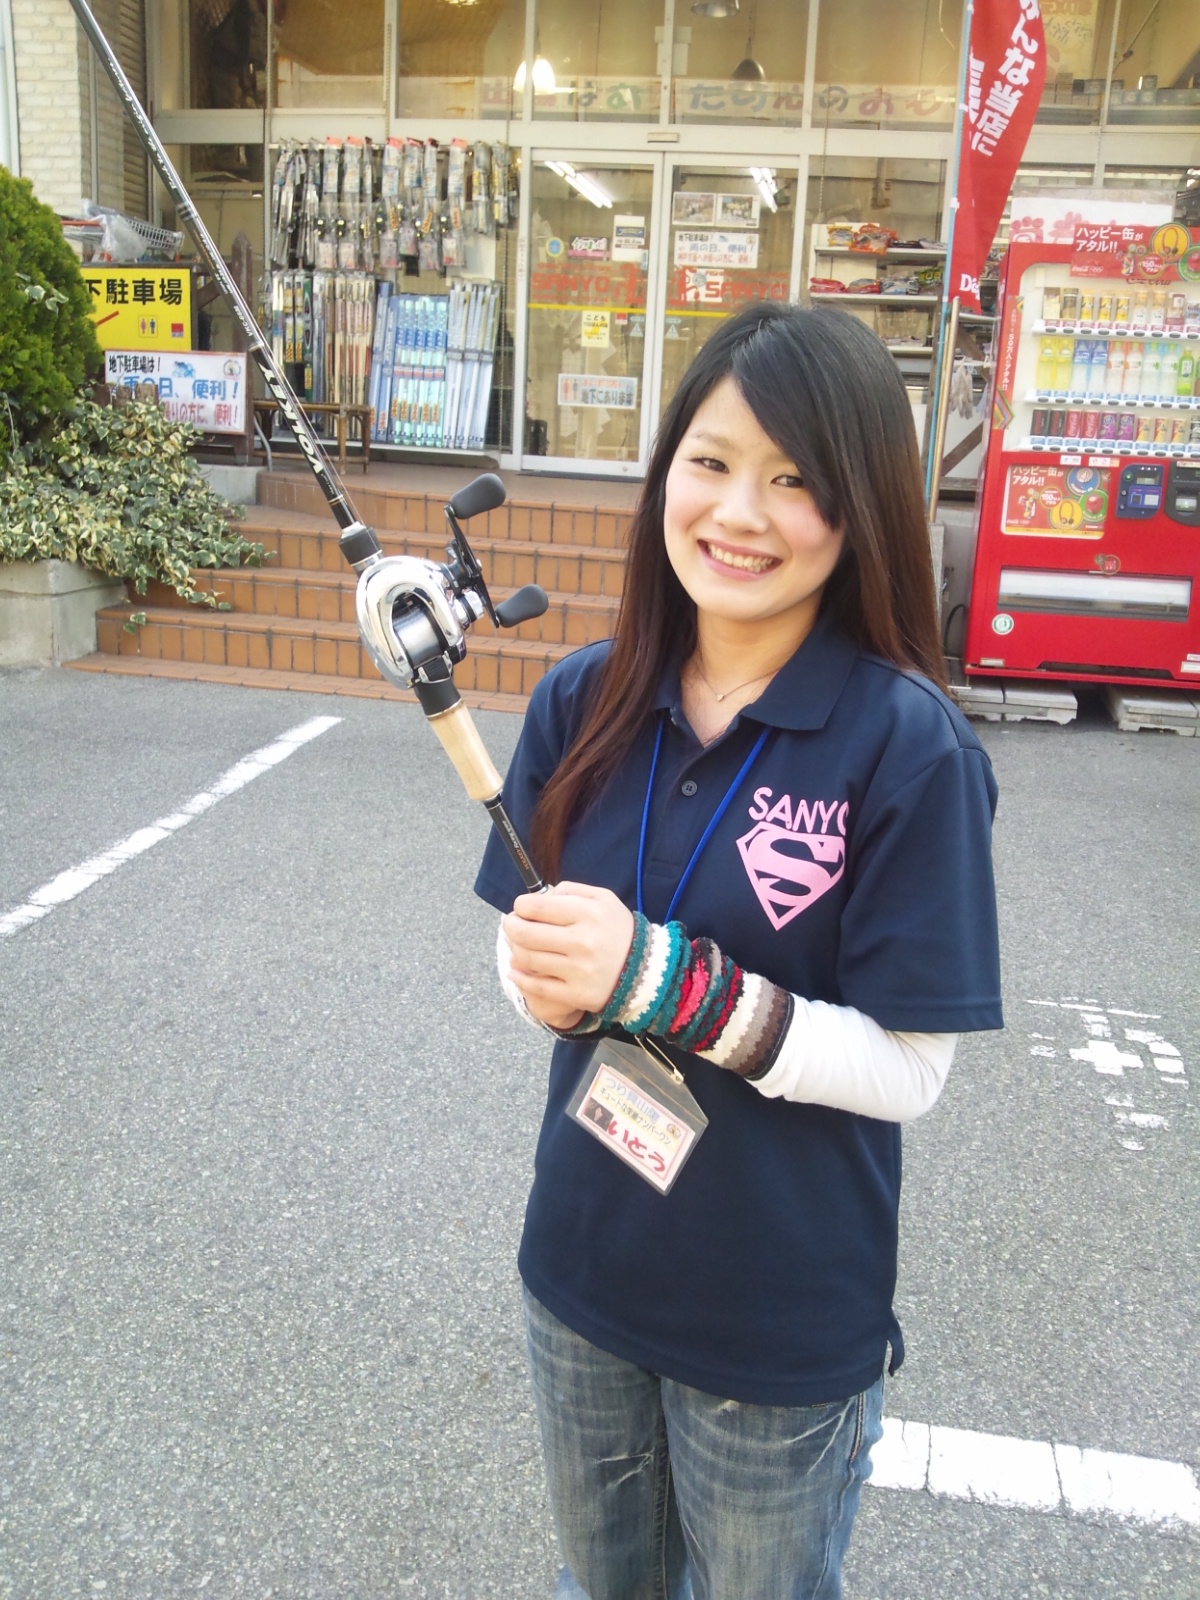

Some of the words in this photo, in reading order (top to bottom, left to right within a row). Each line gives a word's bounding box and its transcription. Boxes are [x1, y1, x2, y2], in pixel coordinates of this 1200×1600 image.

[1076, 227, 1143, 241] ハッピー缶が
[1076, 240, 1118, 253] アタル!!
[85, 278, 183, 306] 下駐車場
[705, 281, 787, 300] SANYO
[108, 356, 161, 373] 地下駐車場は！
[192, 379, 239, 400] 便利！
[258, 362, 324, 474] VOLKEY
[1012, 475, 1045, 486] アタル!!
[1013, 466, 1064, 477] ハッピー缶が
[608, 1120, 665, 1172] いとう
